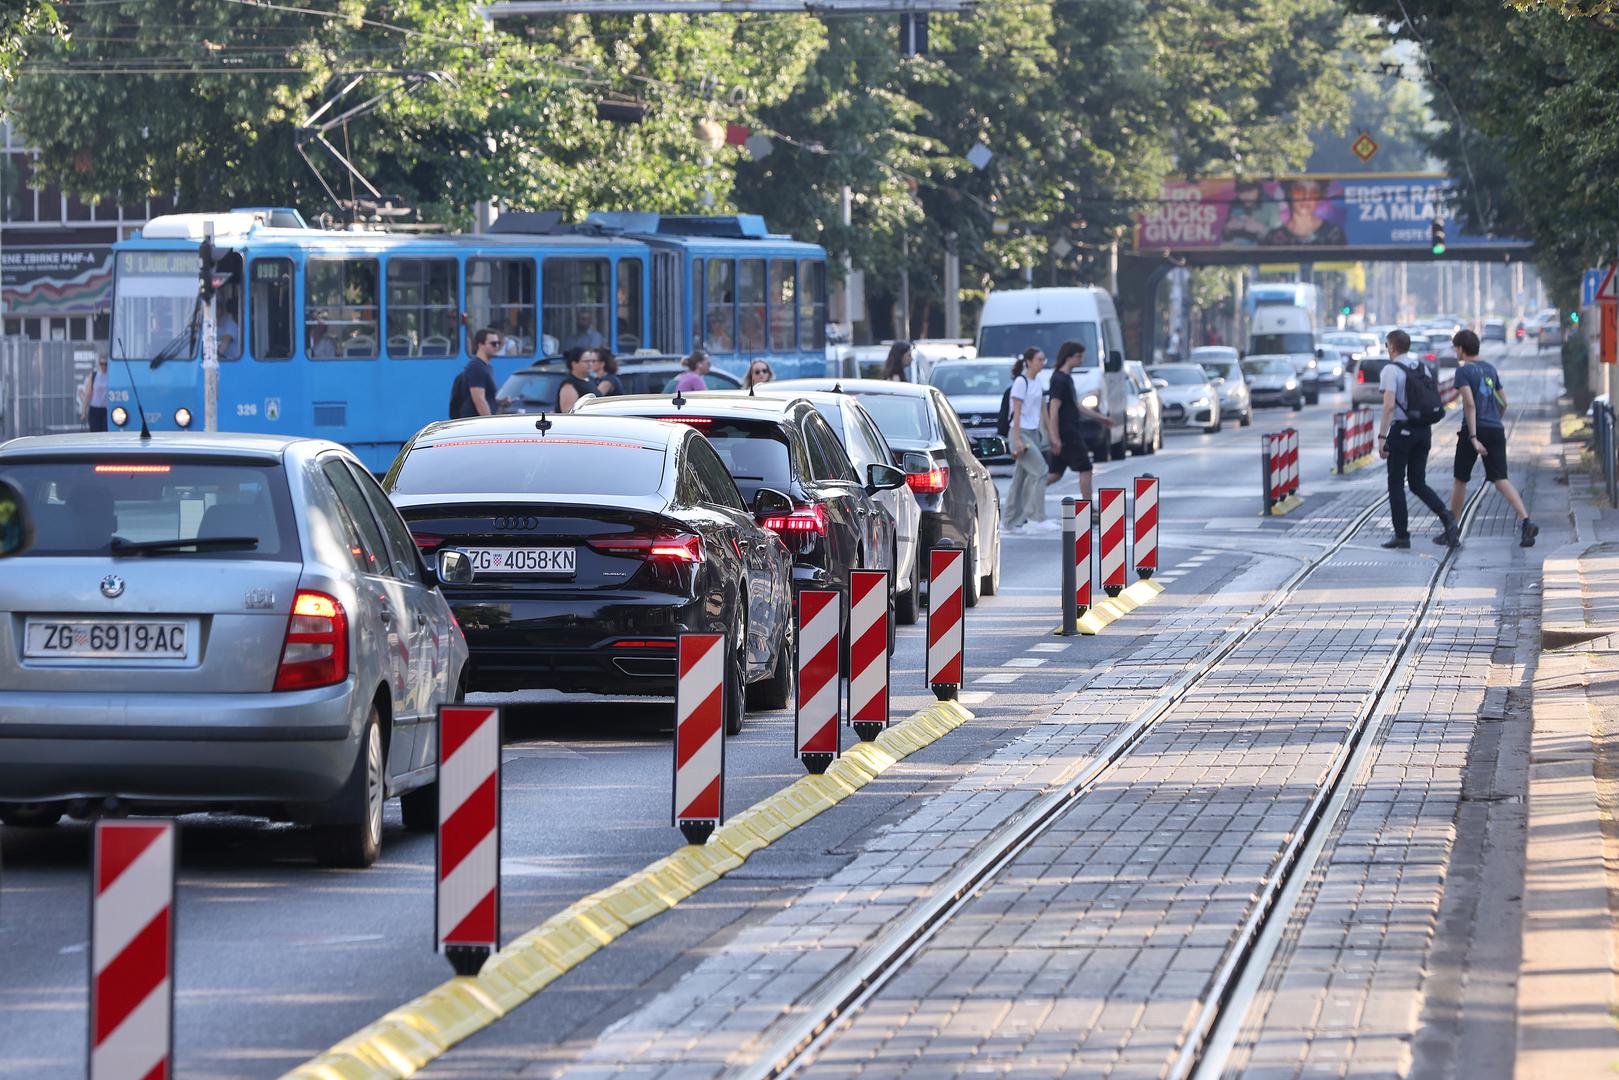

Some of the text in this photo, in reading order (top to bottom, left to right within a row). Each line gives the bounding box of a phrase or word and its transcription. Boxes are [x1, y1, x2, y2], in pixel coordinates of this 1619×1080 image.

[1344, 186, 1408, 204] ERSTE
[1360, 203, 1388, 221] ZA
[1145, 223, 1217, 242] GIVEN.
[24, 253, 60, 265] ZBIRKE
[108, 390, 129, 401] 326
[236, 403, 257, 416] 326
[469, 550, 491, 569] ZG
[43, 625, 74, 650] ZG
